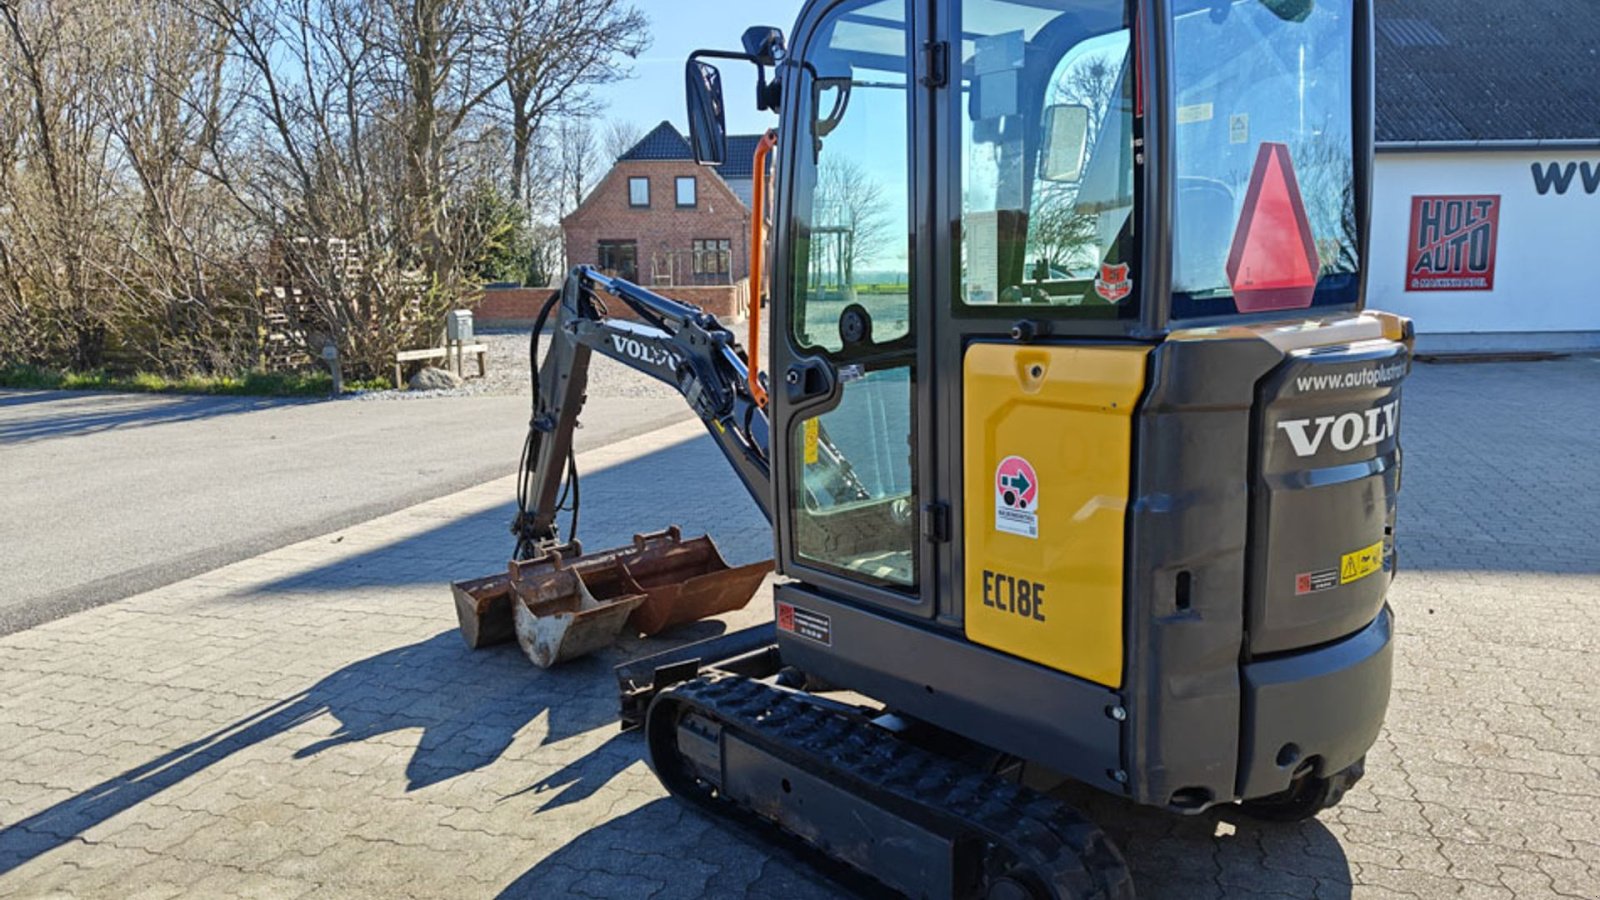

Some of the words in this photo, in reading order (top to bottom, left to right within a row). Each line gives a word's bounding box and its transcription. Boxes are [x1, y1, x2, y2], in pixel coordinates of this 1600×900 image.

[1413, 222, 1490, 273] AUTO
[1419, 199, 1493, 249] HOLT
[982, 569, 1046, 622] EC18E
